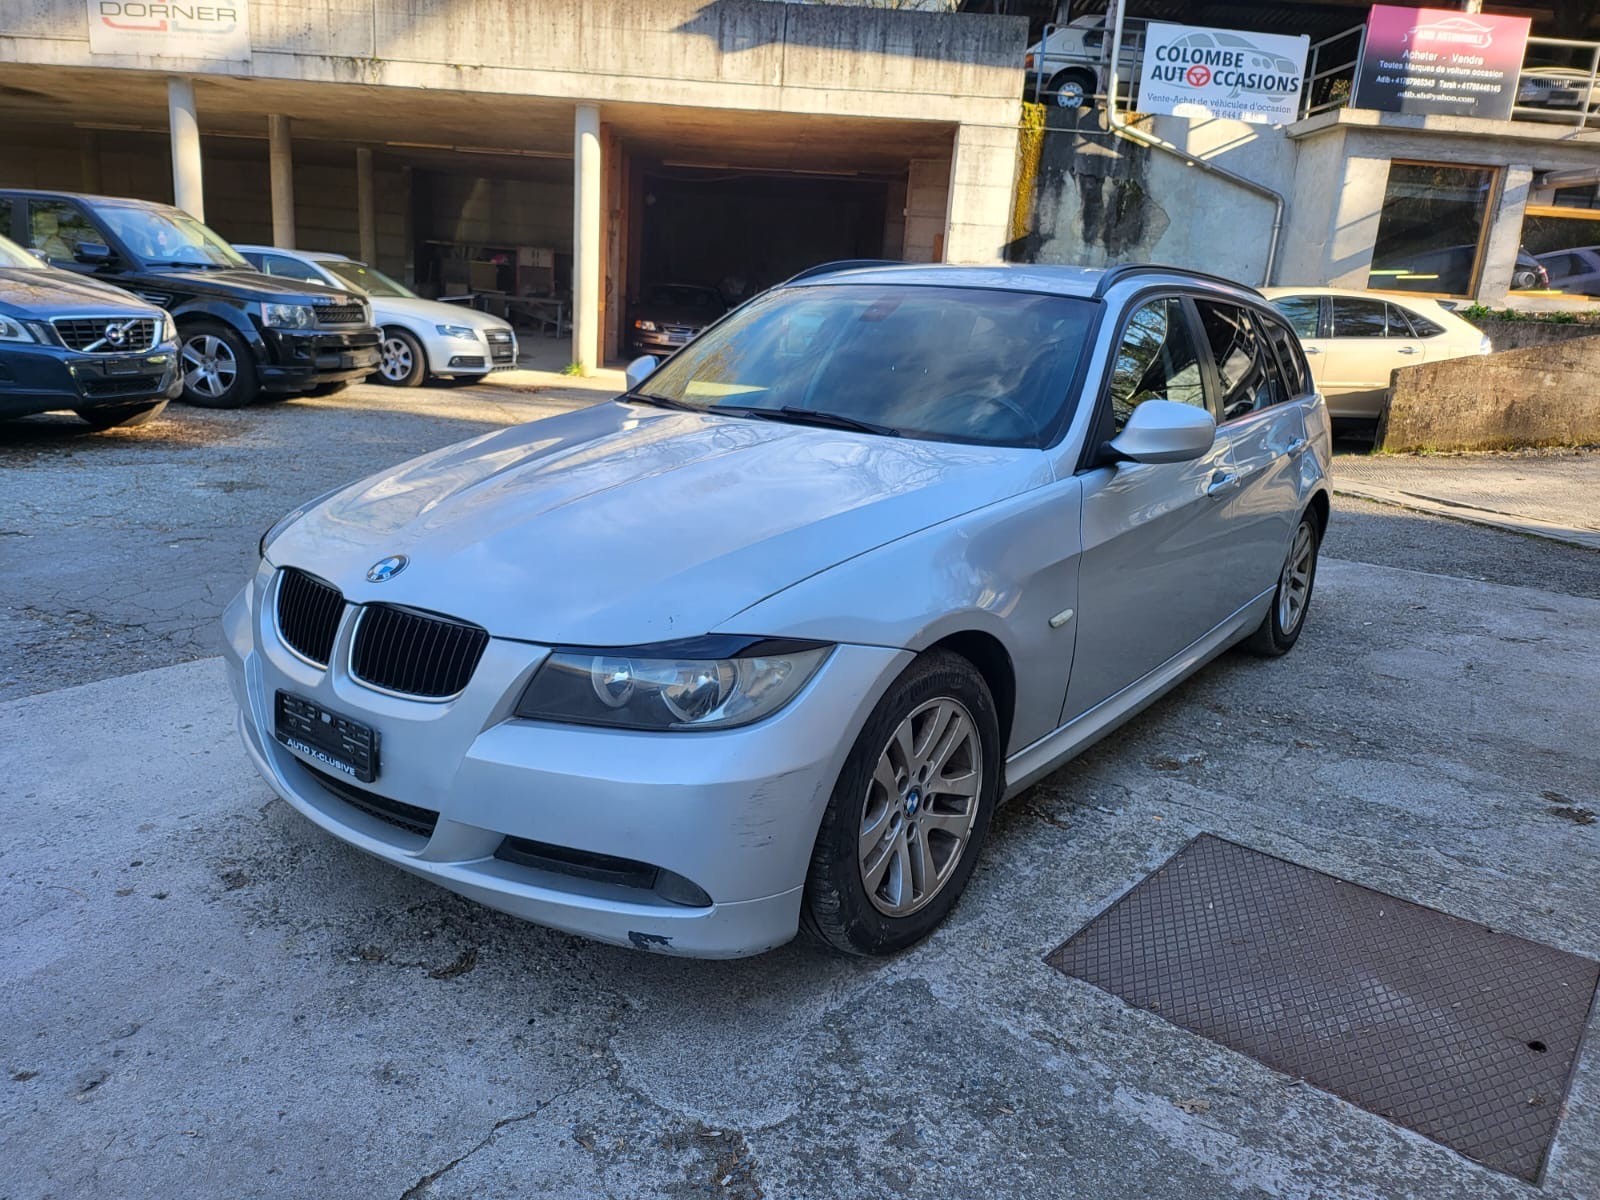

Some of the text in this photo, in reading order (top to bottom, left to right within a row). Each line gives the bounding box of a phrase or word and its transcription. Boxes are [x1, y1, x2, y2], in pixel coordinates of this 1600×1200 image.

[100, 1, 237, 22] DORNER
[1156, 45, 1245, 68] COLOMBE
[1403, 50, 1438, 62] Acheter
[1452, 53, 1485, 66] Vendre
[1379, 60, 1403, 70] Toutes
[1405, 62, 1435, 74] Marques
[1436, 65, 1445, 73] de
[1471, 69, 1504, 79] occasion
[1147, 92, 1196, 104] Vente-Achat
[1198, 97, 1208, 106] de
[1210, 98, 1249, 111] véhicules
[1249, 101, 1292, 114] d'occasion
[287, 738, 310, 755] AUTO
